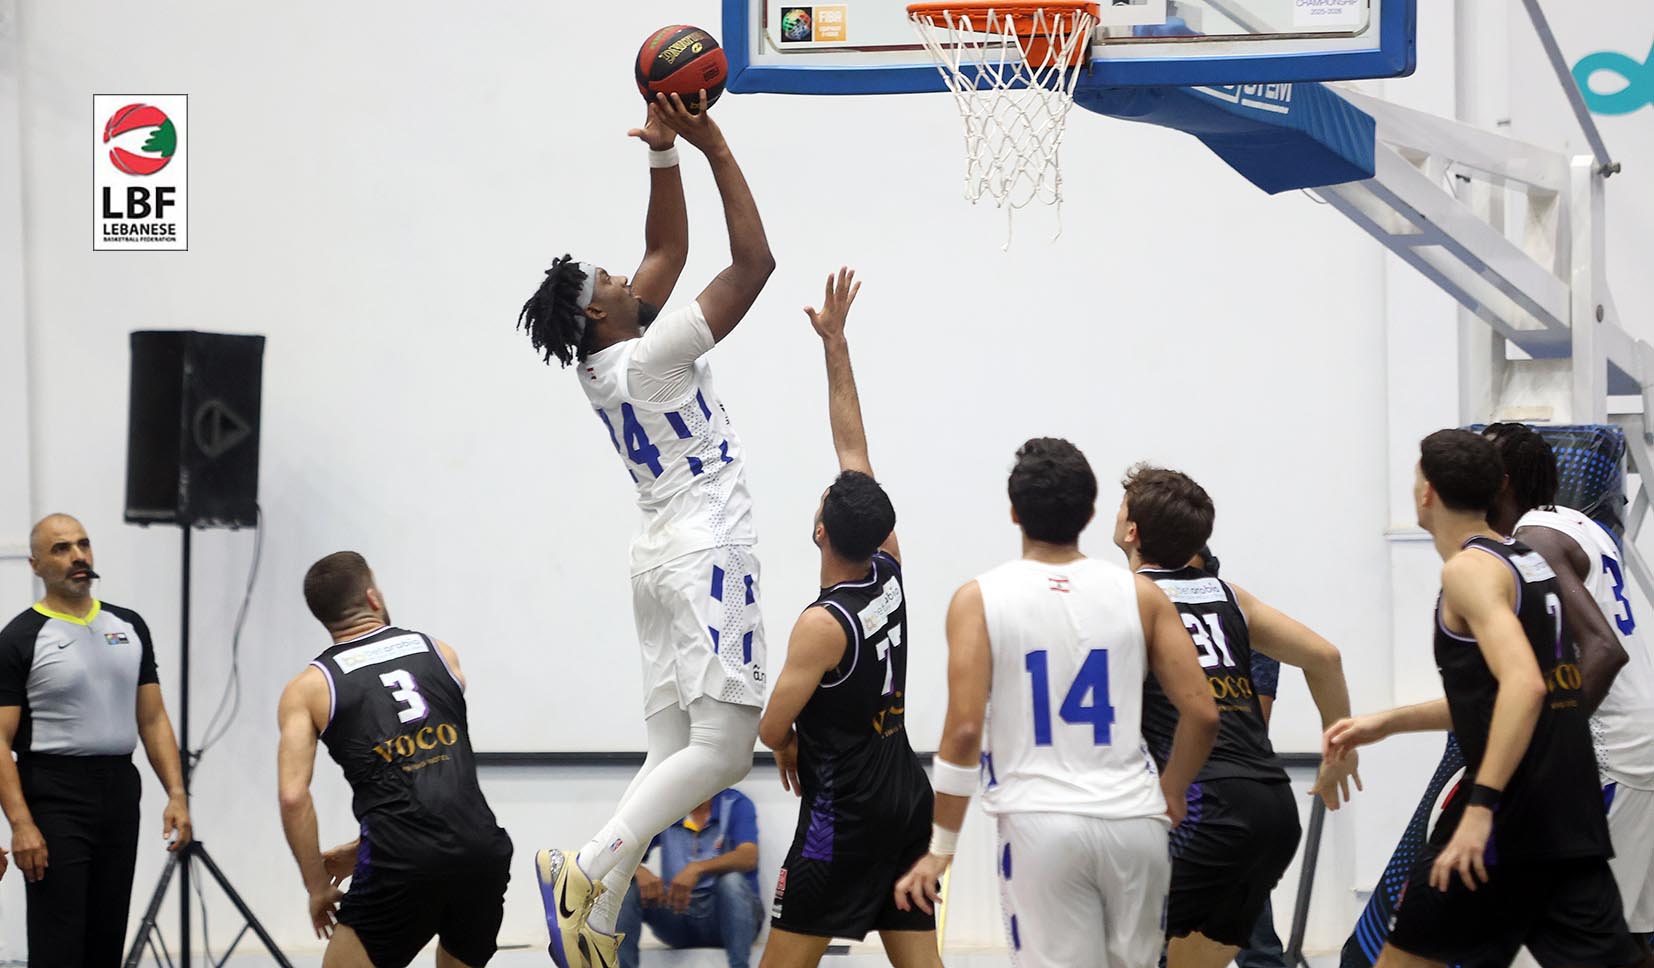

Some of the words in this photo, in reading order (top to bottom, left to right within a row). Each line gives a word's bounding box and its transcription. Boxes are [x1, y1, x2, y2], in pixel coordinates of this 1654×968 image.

[819, 11, 842, 23] FIBA
[1602, 553, 1636, 636] 3
[1180, 613, 1236, 669] 31
[379, 669, 430, 724] 3
[1025, 649, 1116, 746] 14
[1208, 677, 1252, 699] OCO
[373, 723, 458, 763] VOCO
